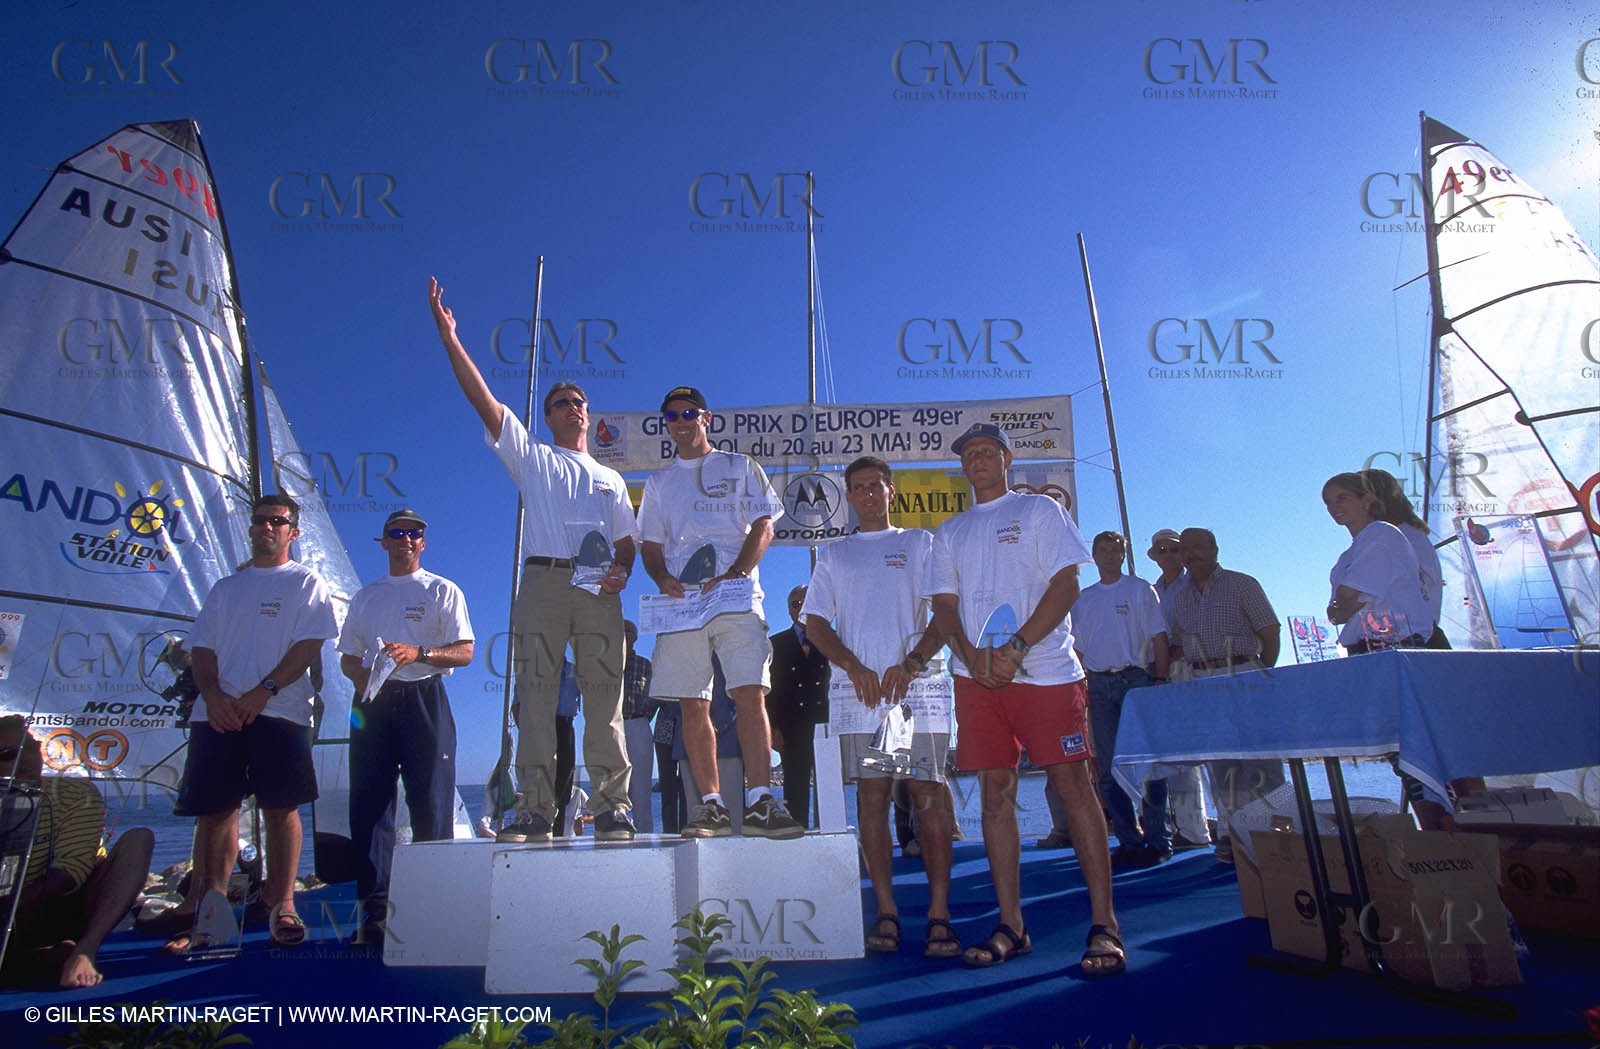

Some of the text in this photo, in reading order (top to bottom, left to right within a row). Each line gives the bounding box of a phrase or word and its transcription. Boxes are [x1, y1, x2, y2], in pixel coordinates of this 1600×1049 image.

[1441, 159, 1517, 195] 49er
[642, 408, 963, 436] GRD PRIX D'EUROPE 49er
[990, 412, 1054, 421] STATION
[751, 436, 775, 457] du
[782, 438, 804, 456] 20
[811, 440, 833, 456] au
[841, 434, 863, 454] 23
[871, 432, 911, 453] MAI
[919, 431, 942, 451] 99
[1014, 440, 1057, 449] BANDOL
[0, 473, 185, 544] ANDOL
[889, 492, 967, 514] ENAULT
[774, 526, 861, 540] OTOROLA
[69, 532, 171, 562] STATION
[77, 546, 146, 568] VOILE
[0, 613, 20, 621] 999
[82, 701, 182, 717] MOTOR
[24, 714, 166, 728] entsbandol.com
